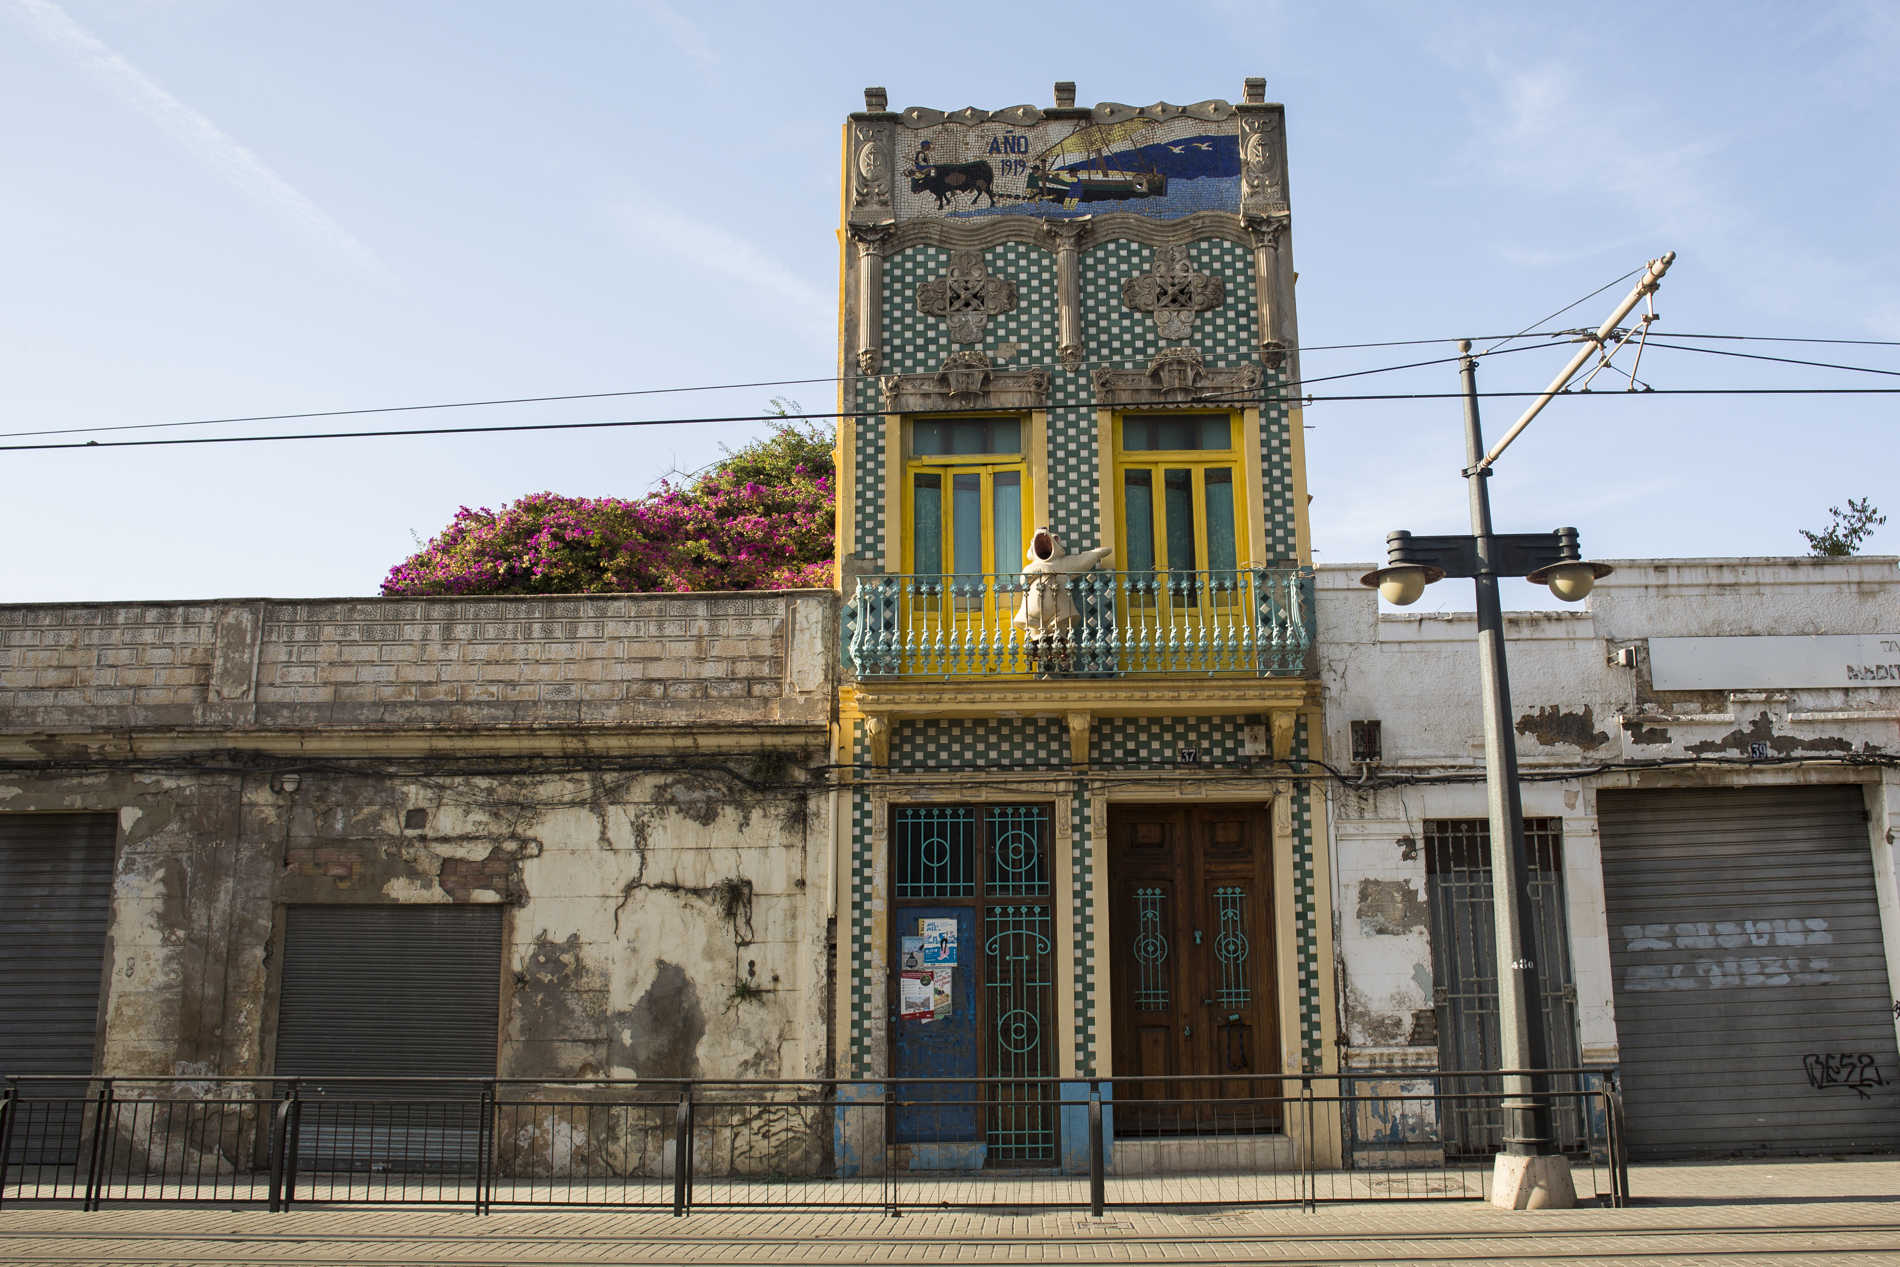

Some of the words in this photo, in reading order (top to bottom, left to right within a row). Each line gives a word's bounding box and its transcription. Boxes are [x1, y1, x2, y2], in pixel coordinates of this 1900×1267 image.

[988, 130, 1029, 154] AÑO
[1001, 159, 1027, 176] 1919
[1182, 749, 1196, 763] 37
[1751, 743, 1767, 759] 39
